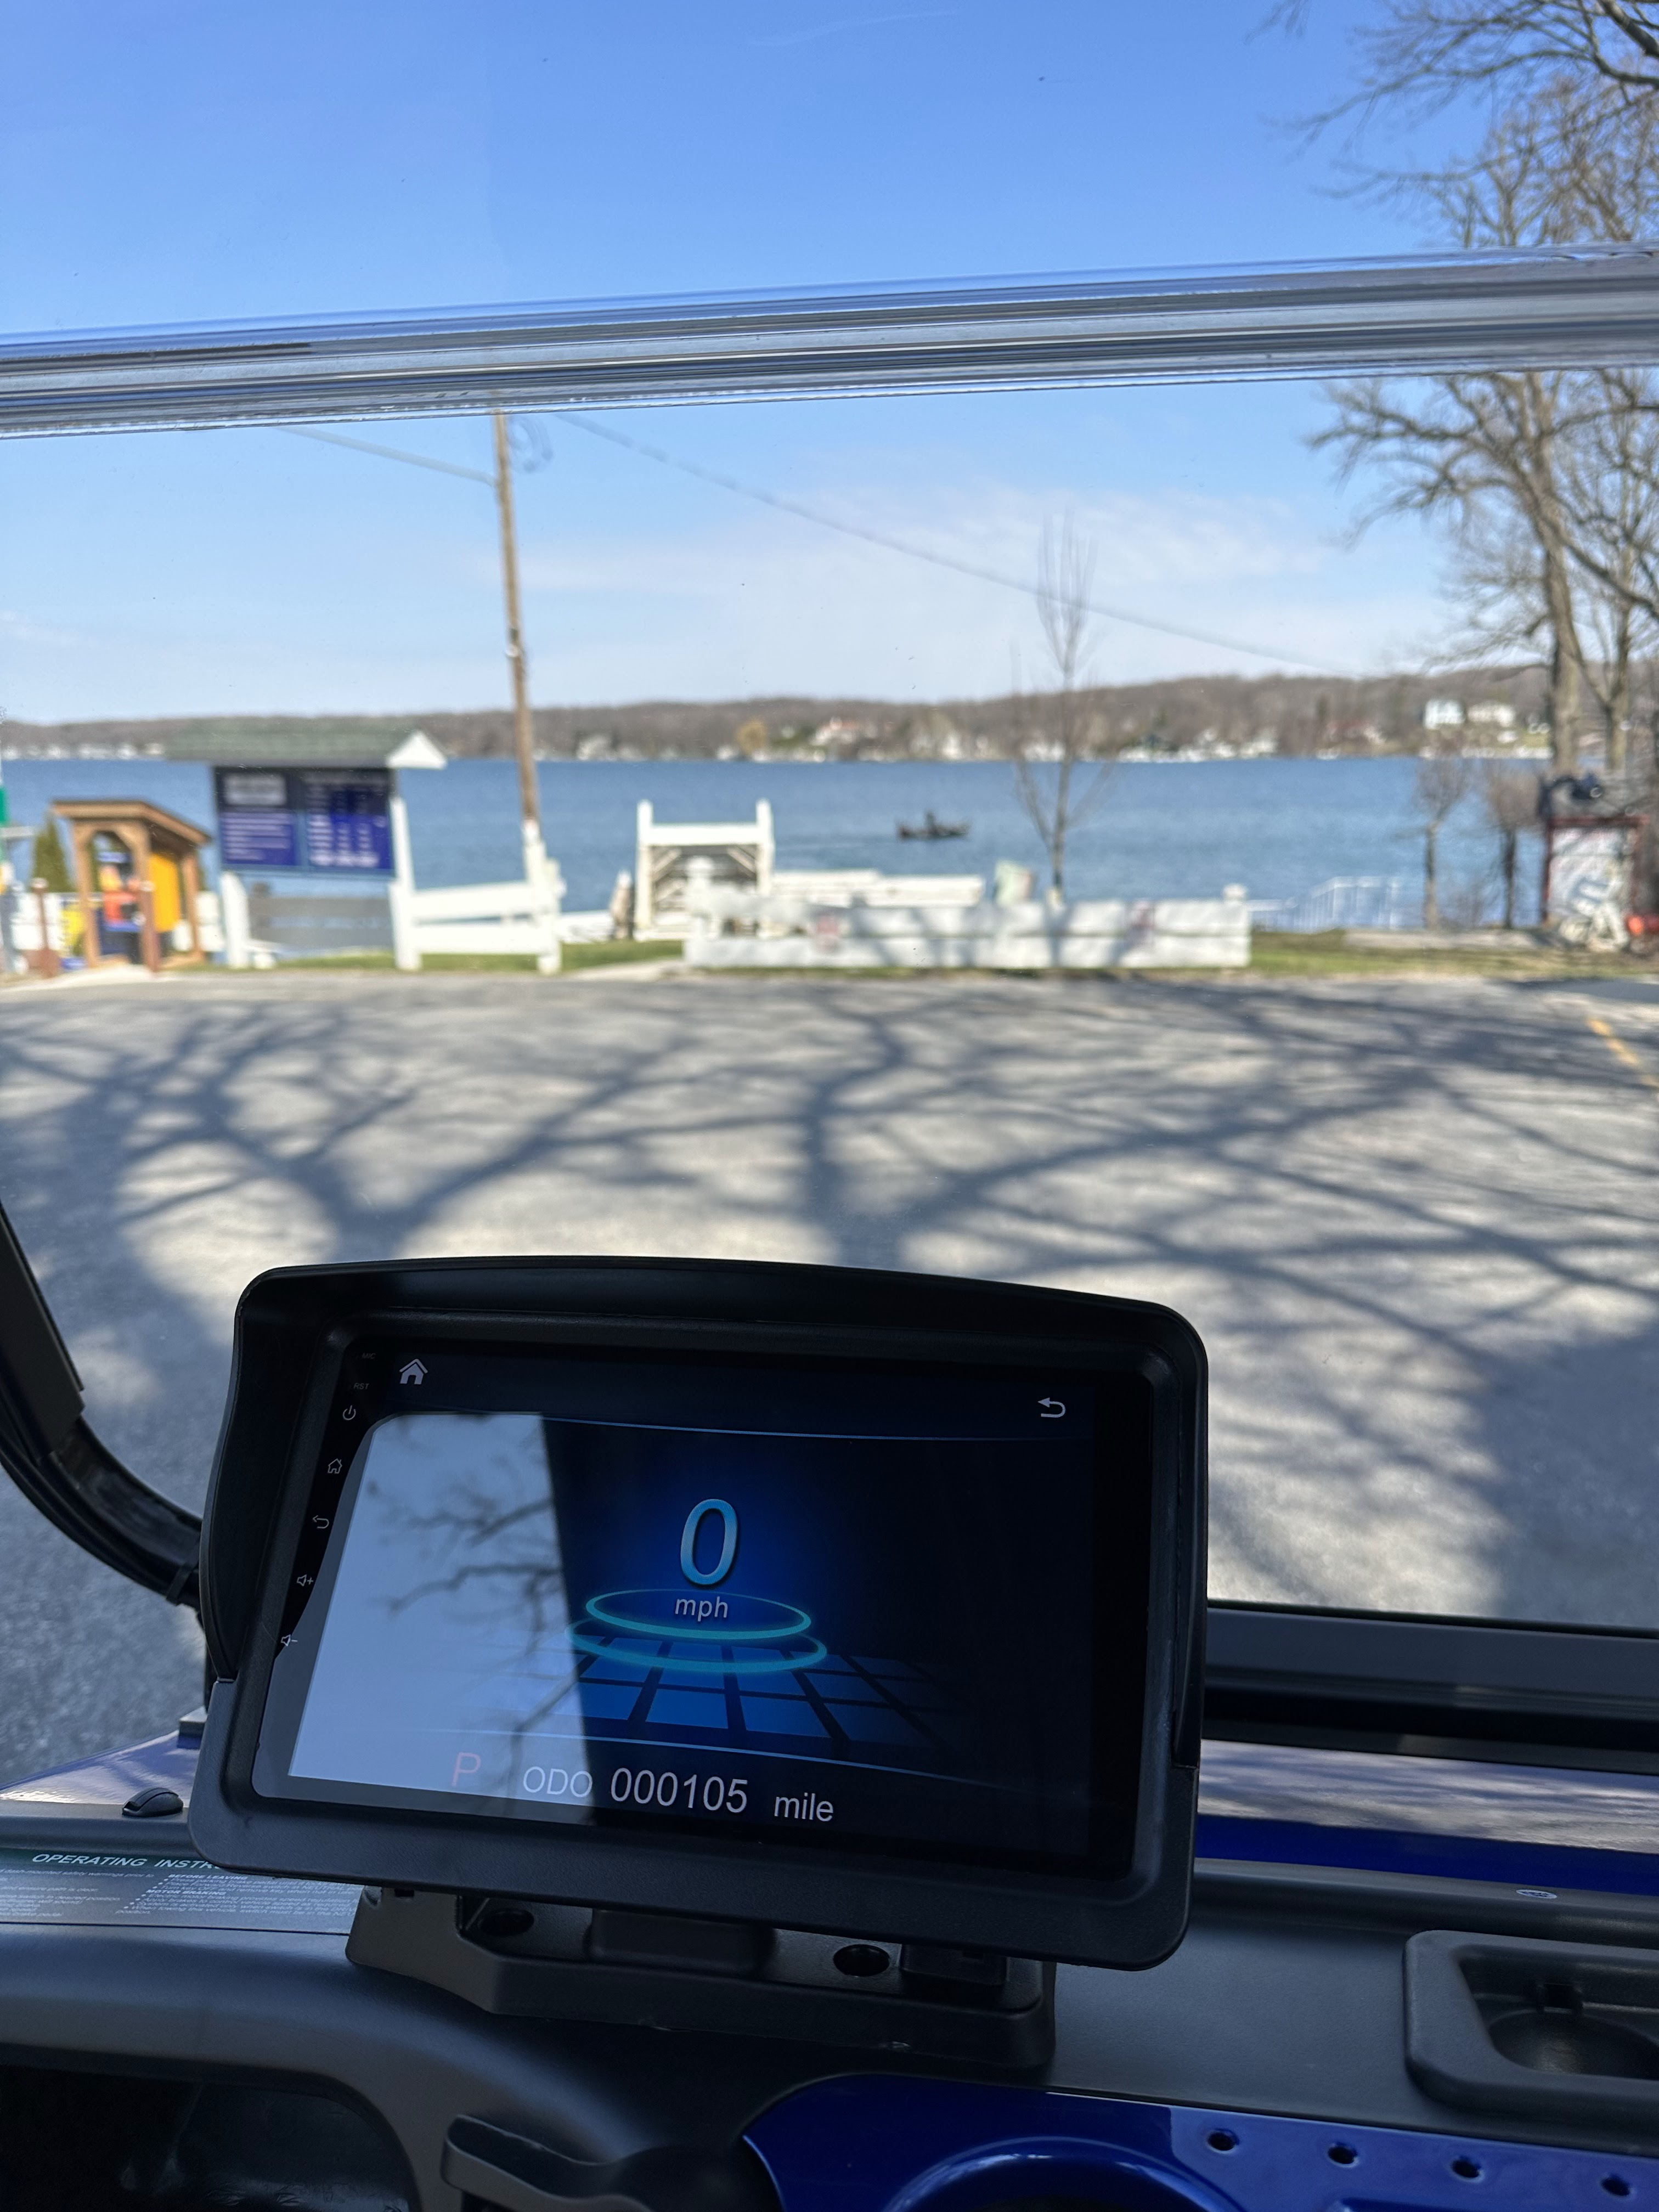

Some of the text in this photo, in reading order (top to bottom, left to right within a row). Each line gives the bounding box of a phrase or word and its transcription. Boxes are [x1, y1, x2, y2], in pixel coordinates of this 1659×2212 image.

[680, 1498, 738, 1585] 0
[675, 1595, 729, 1622] mph
[452, 1752, 481, 1787] P
[523, 1766, 834, 1822] ODO 000105 mile
[32, 1854, 219, 1869] OPERATING INSTR
